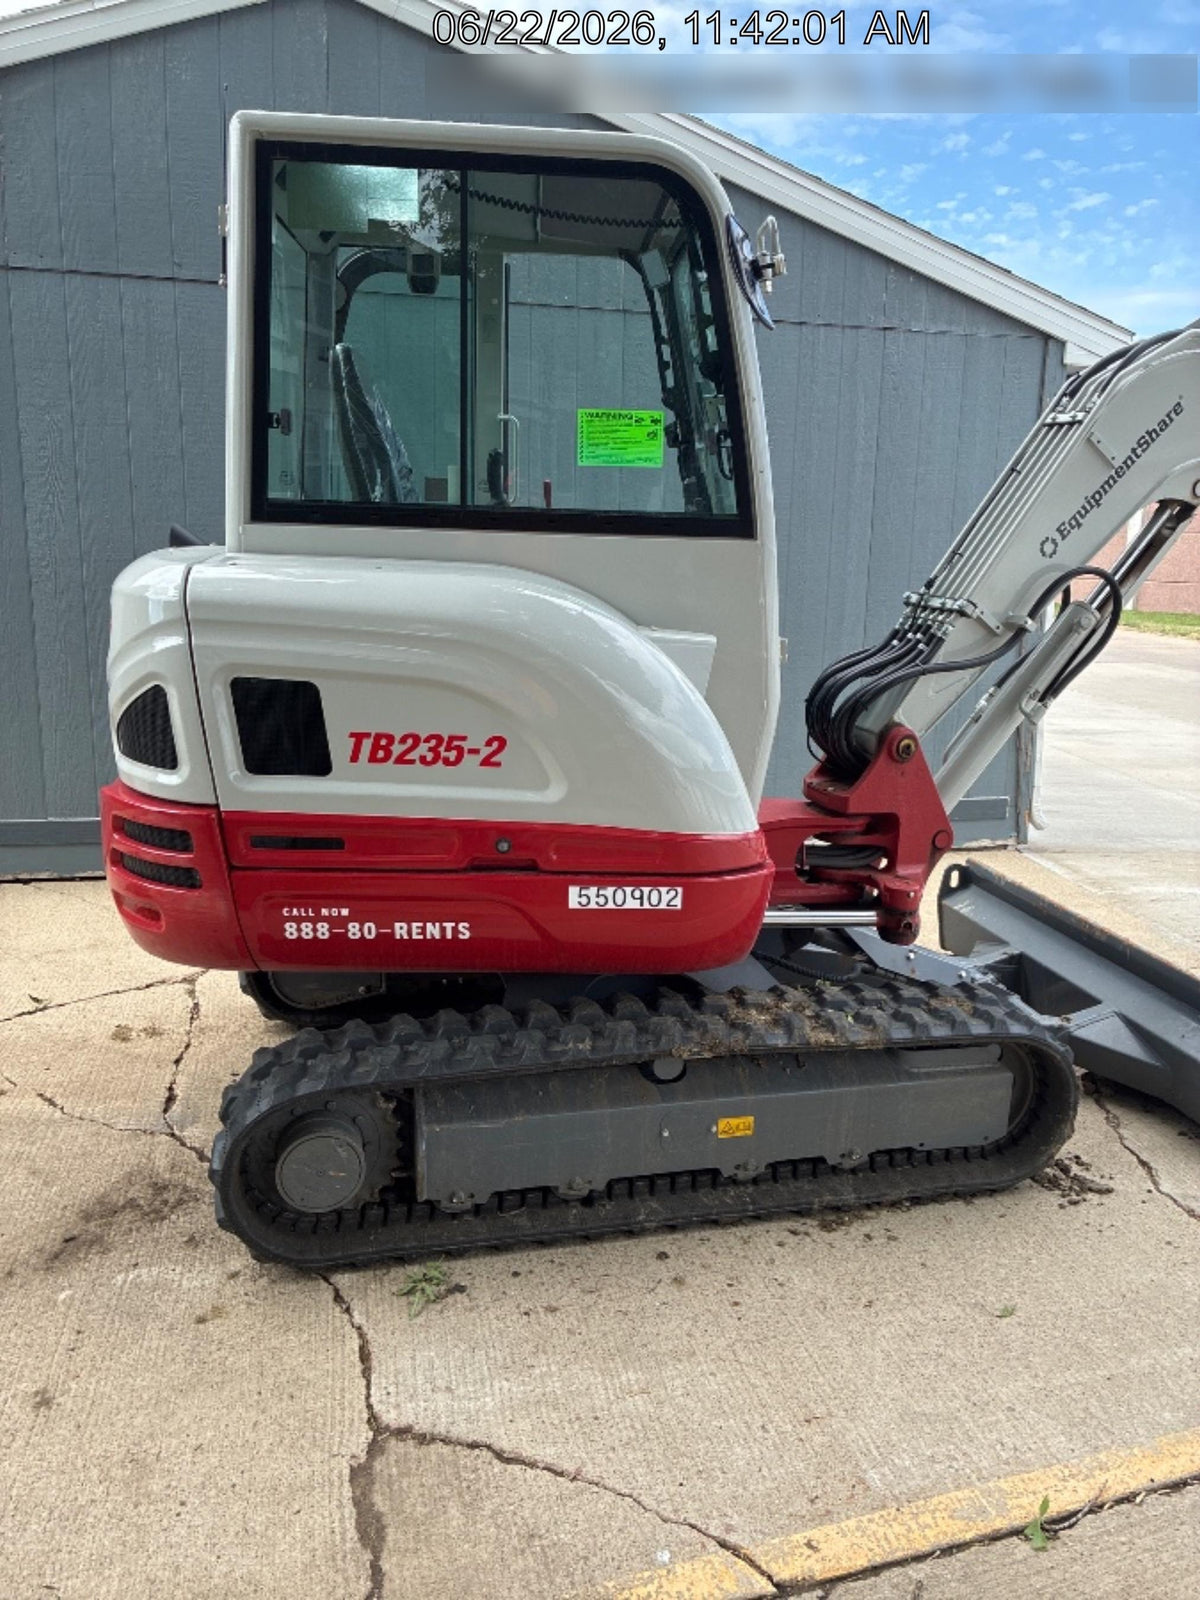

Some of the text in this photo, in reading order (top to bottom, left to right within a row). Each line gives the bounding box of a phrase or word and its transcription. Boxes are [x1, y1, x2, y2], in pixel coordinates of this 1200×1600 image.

[585, 412, 633, 421] WARNING
[1056, 401, 1184, 541] EquipmentShare
[348, 732, 507, 767] TB235-2
[577, 886, 679, 907] 550902
[282, 908, 350, 916] CALL NOW
[283, 922, 471, 939] 888-80-RENTS
